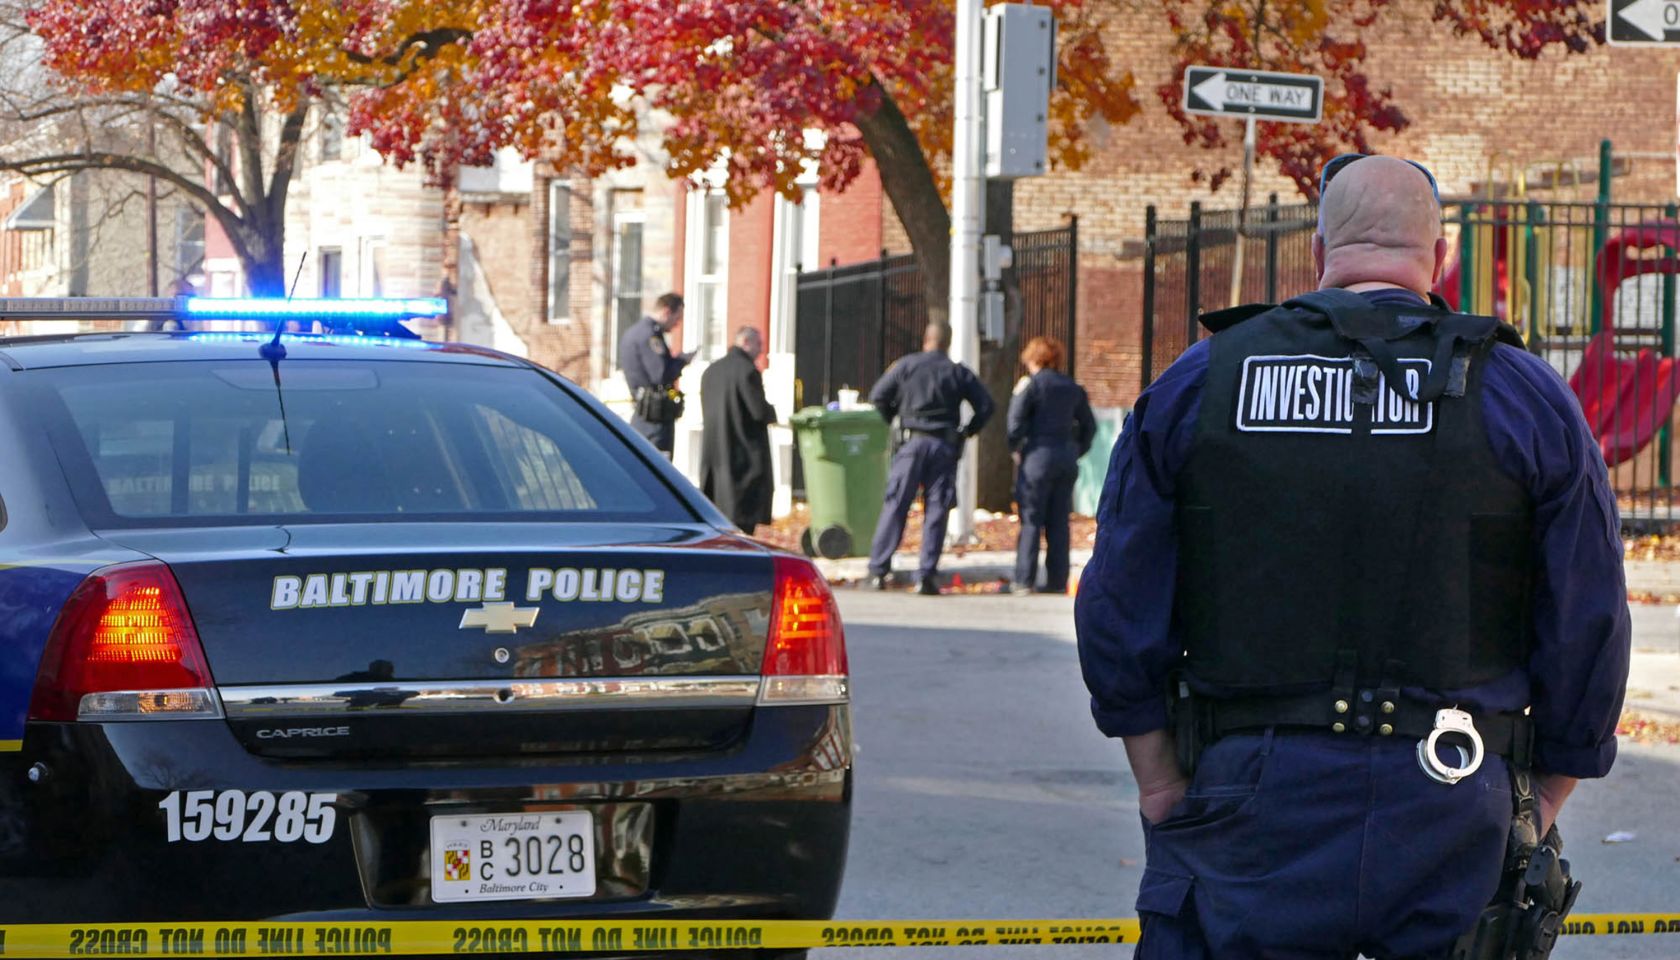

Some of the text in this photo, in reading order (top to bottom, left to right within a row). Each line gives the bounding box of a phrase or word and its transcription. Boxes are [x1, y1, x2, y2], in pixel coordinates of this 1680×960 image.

[1226, 83, 1306, 105] ONE WAY
[1249, 364, 1419, 424] INVESTITOR
[271, 568, 664, 610] BALTIMORE POLICE
[256, 726, 351, 739] CAPRICE
[158, 789, 338, 844] 159285
[480, 816, 542, 836] Maryland
[505, 834, 585, 877] 3028
[479, 881, 549, 894] Baltimore City
